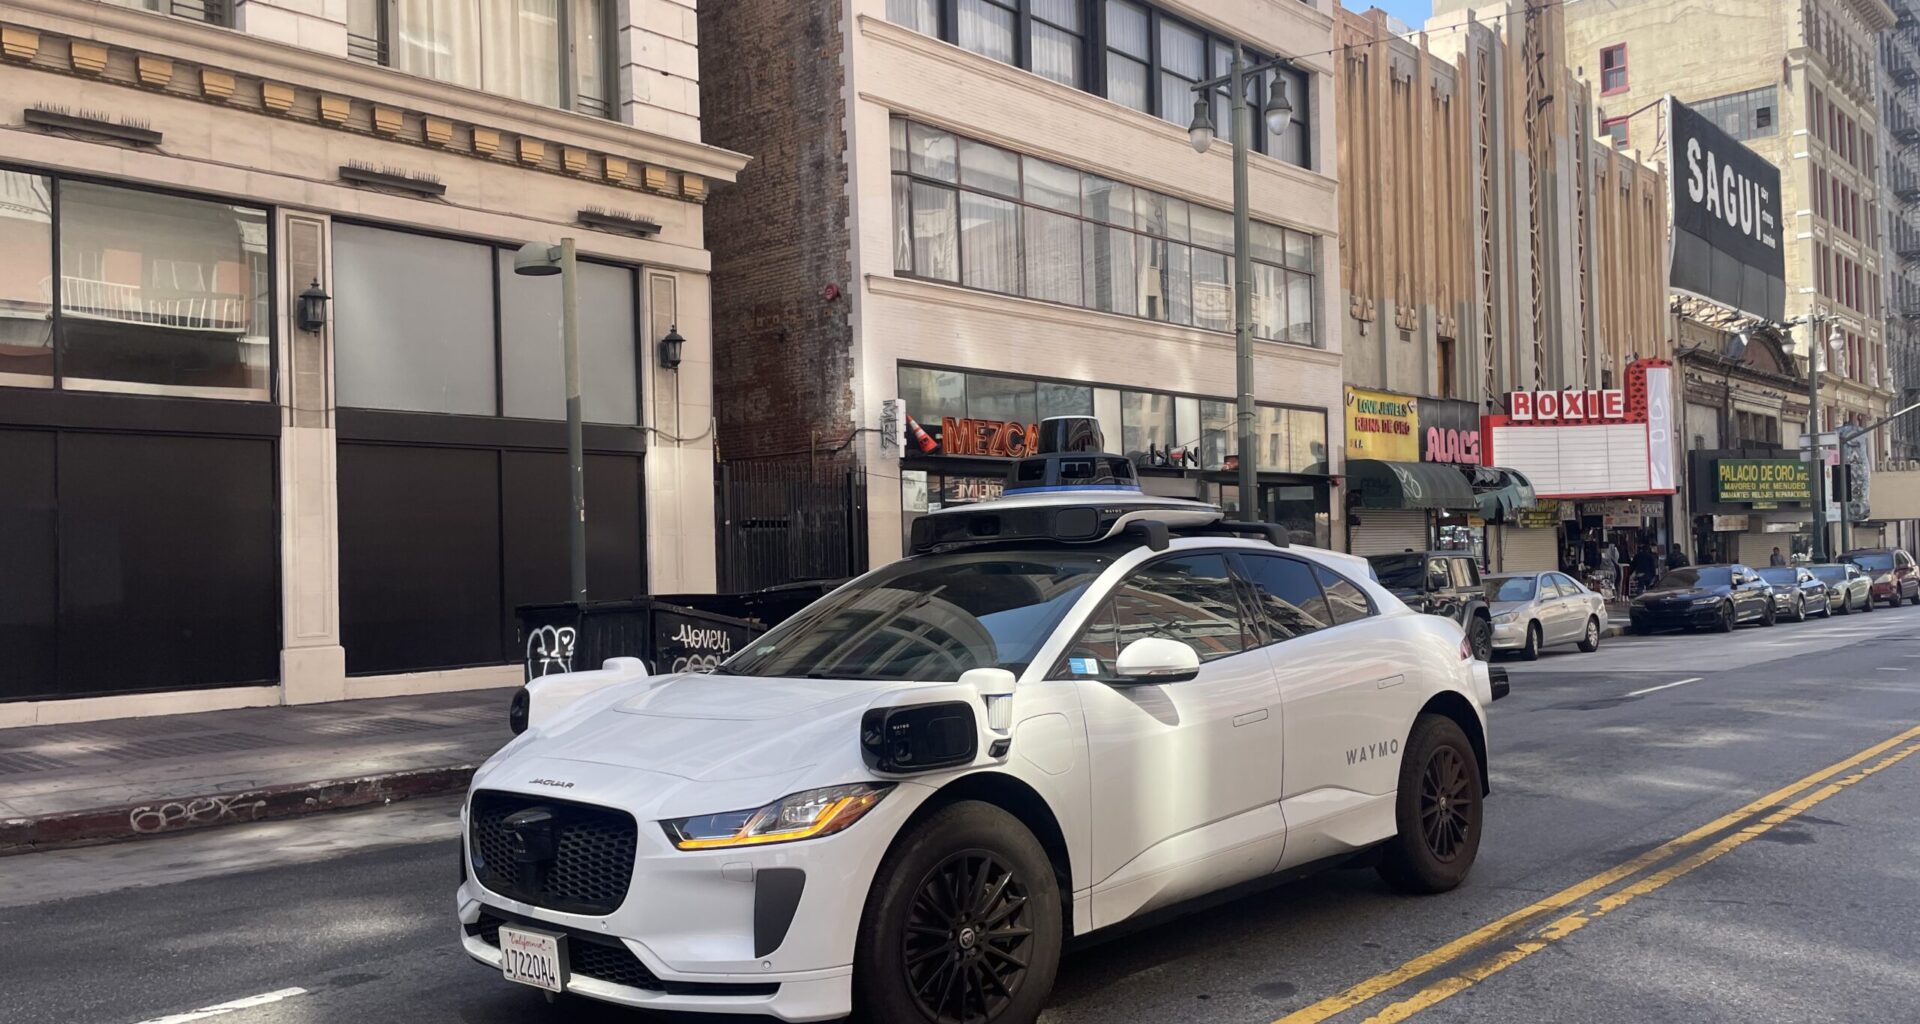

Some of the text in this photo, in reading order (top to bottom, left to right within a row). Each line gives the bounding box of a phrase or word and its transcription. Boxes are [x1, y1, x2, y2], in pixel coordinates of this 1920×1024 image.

[1687, 137, 1761, 241] SAGUI
[1513, 392, 1622, 417] ROXIE
[1382, 419, 1392, 433] DE
[1720, 465, 1758, 480] PALACIO
[1761, 465, 1774, 480] DE
[1775, 465, 1795, 480] ORO
[1773, 482, 1806, 490] MENUDEO
[1346, 739, 1399, 766] WAYMO
[528, 778, 575, 789] JAGUAR
[505, 948, 556, 987] 17220A4
